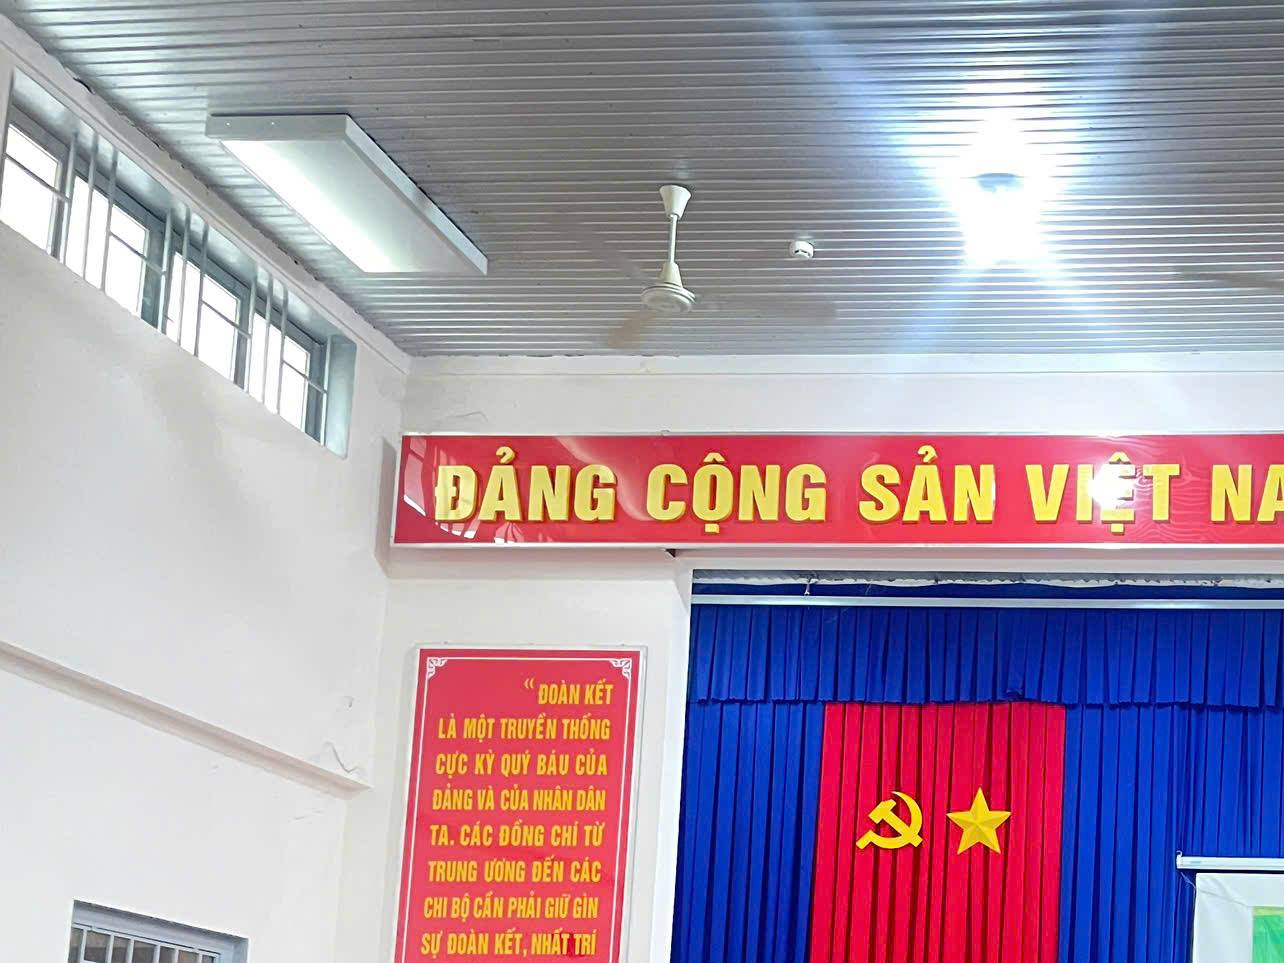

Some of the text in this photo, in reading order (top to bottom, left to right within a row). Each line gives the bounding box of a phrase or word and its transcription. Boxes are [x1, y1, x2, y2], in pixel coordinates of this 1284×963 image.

[434, 447, 618, 523] ĐẢNG
[645, 453, 829, 534] CỘNG
[858, 445, 997, 523] SẢN
[1025, 453, 1181, 534] VIỆT
[585, 679, 613, 704] KẾT
[438, 713, 610, 742] LÀ MỘT TRUYỀN THỐNG
[436, 749, 607, 778] CỰC KỲ QUÝ BÁU CỦA
[433, 783, 605, 811] ĐẢNG VÀ CỦA NHÂN DÂN
[430, 819, 605, 846] TA. CÁC ĐỒNG CHÍ TỪ
[428, 855, 601, 882] TRUNG ƯƠNG ĐẾN CÁC
[424, 897, 447, 918] CHI
[451, 893, 470, 922] BỘ
[508, 891, 541, 918] PHẢI
[545, 894, 570, 918] GIỮ
[573, 893, 598, 918] GÌN
[421, 928, 596, 958] SỰ ĐOÀN KẾT, NHẤT TRÍ
